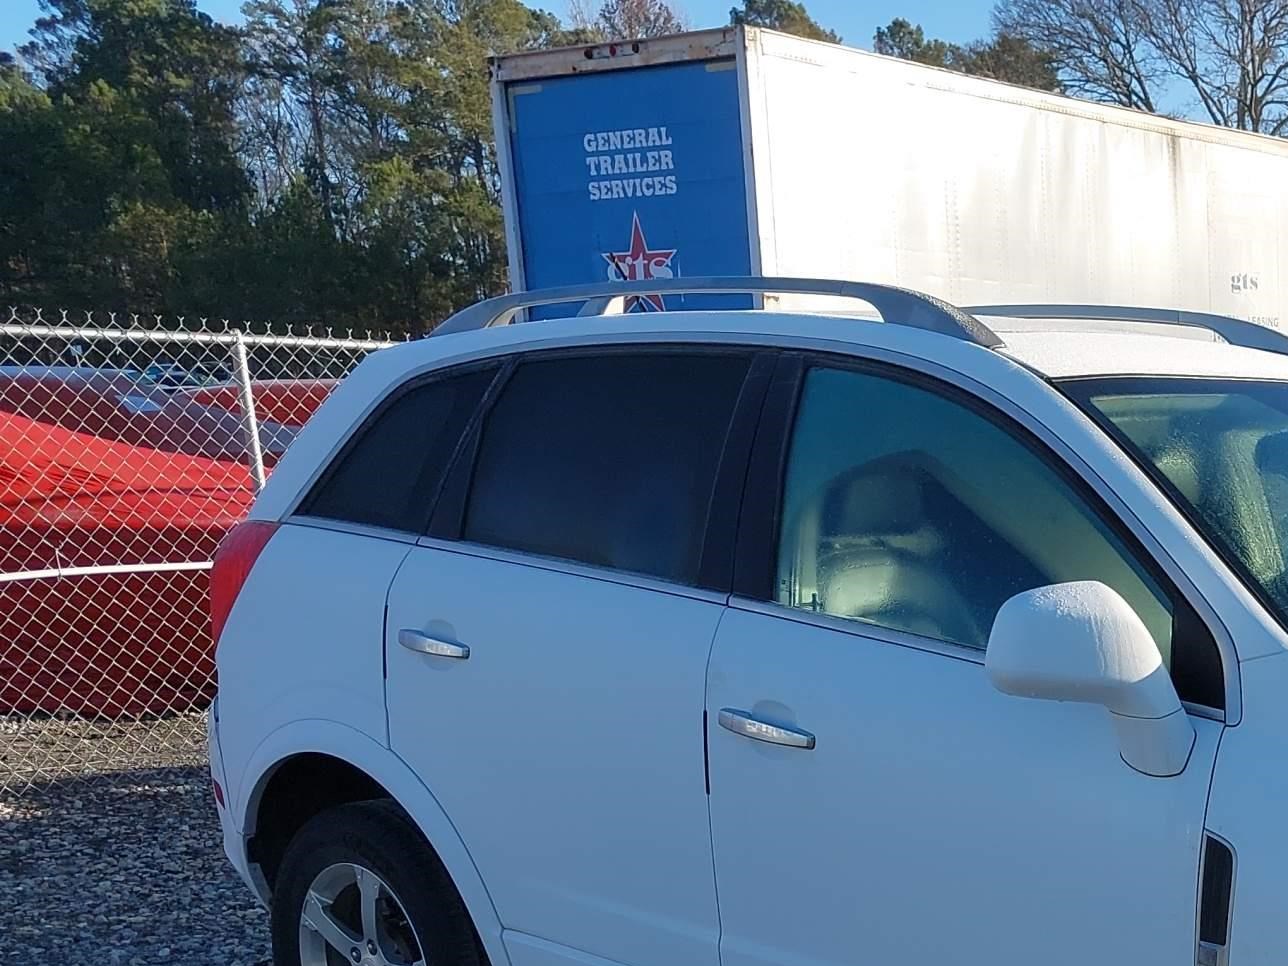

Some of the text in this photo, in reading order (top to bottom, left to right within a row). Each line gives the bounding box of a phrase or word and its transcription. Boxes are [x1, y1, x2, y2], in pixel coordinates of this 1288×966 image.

[583, 127, 672, 152] GENERAL
[586, 151, 674, 176] TRAILER
[589, 176, 677, 200] SERVICES
[1231, 273, 1258, 293] gts
